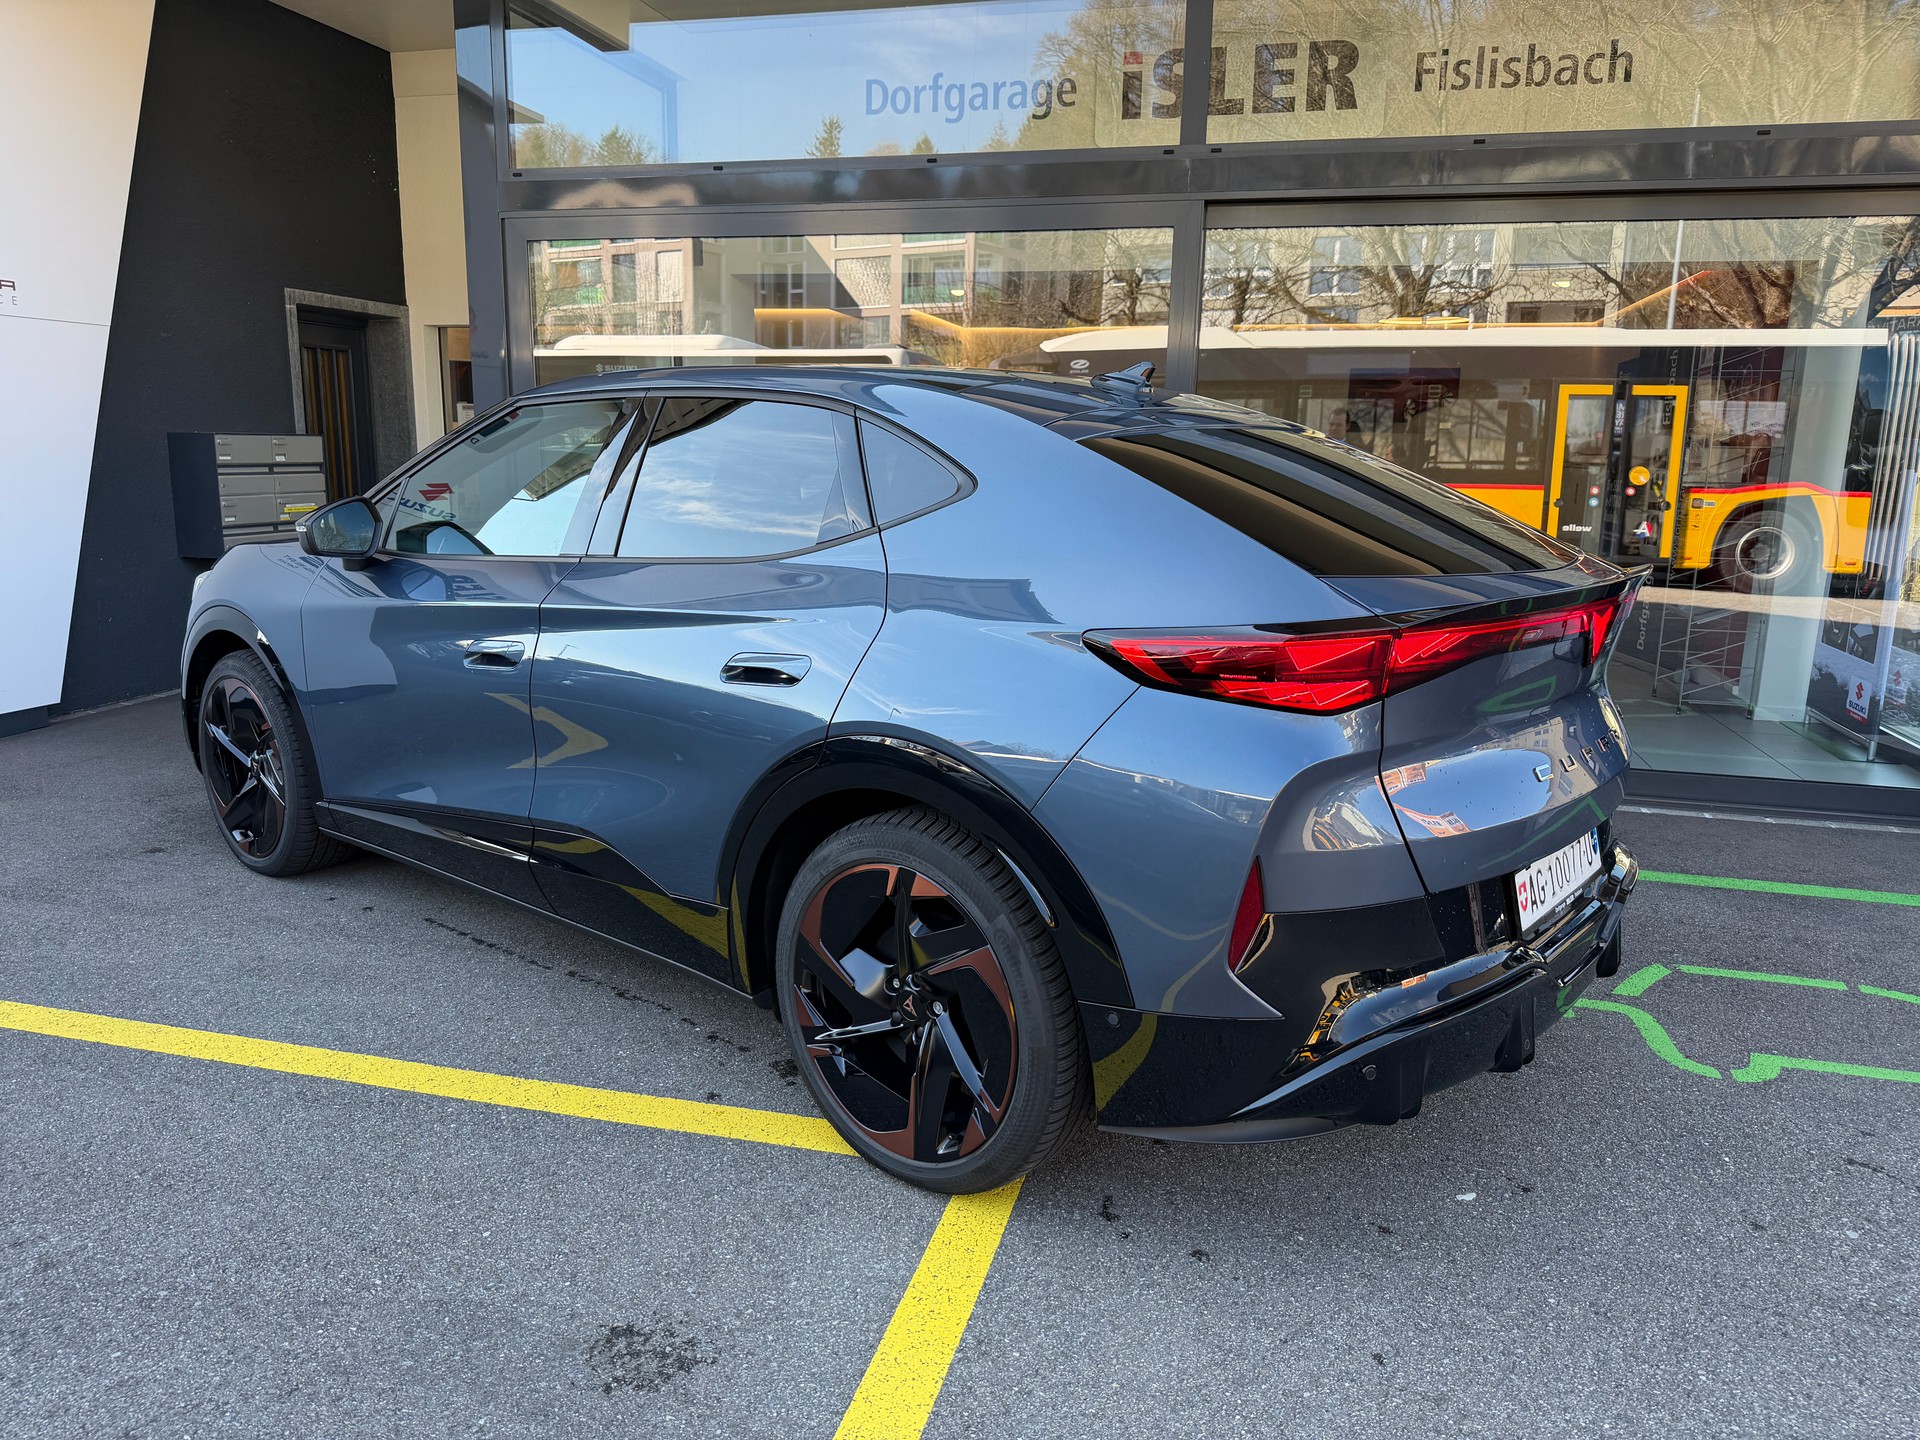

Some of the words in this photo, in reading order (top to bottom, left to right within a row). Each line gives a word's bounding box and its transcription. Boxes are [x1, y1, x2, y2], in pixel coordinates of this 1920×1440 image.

[865, 72, 1077, 124] Dorfgarage
[1414, 38, 1634, 93] Fislisbach
[1848, 700, 1867, 715] SUZUKI
